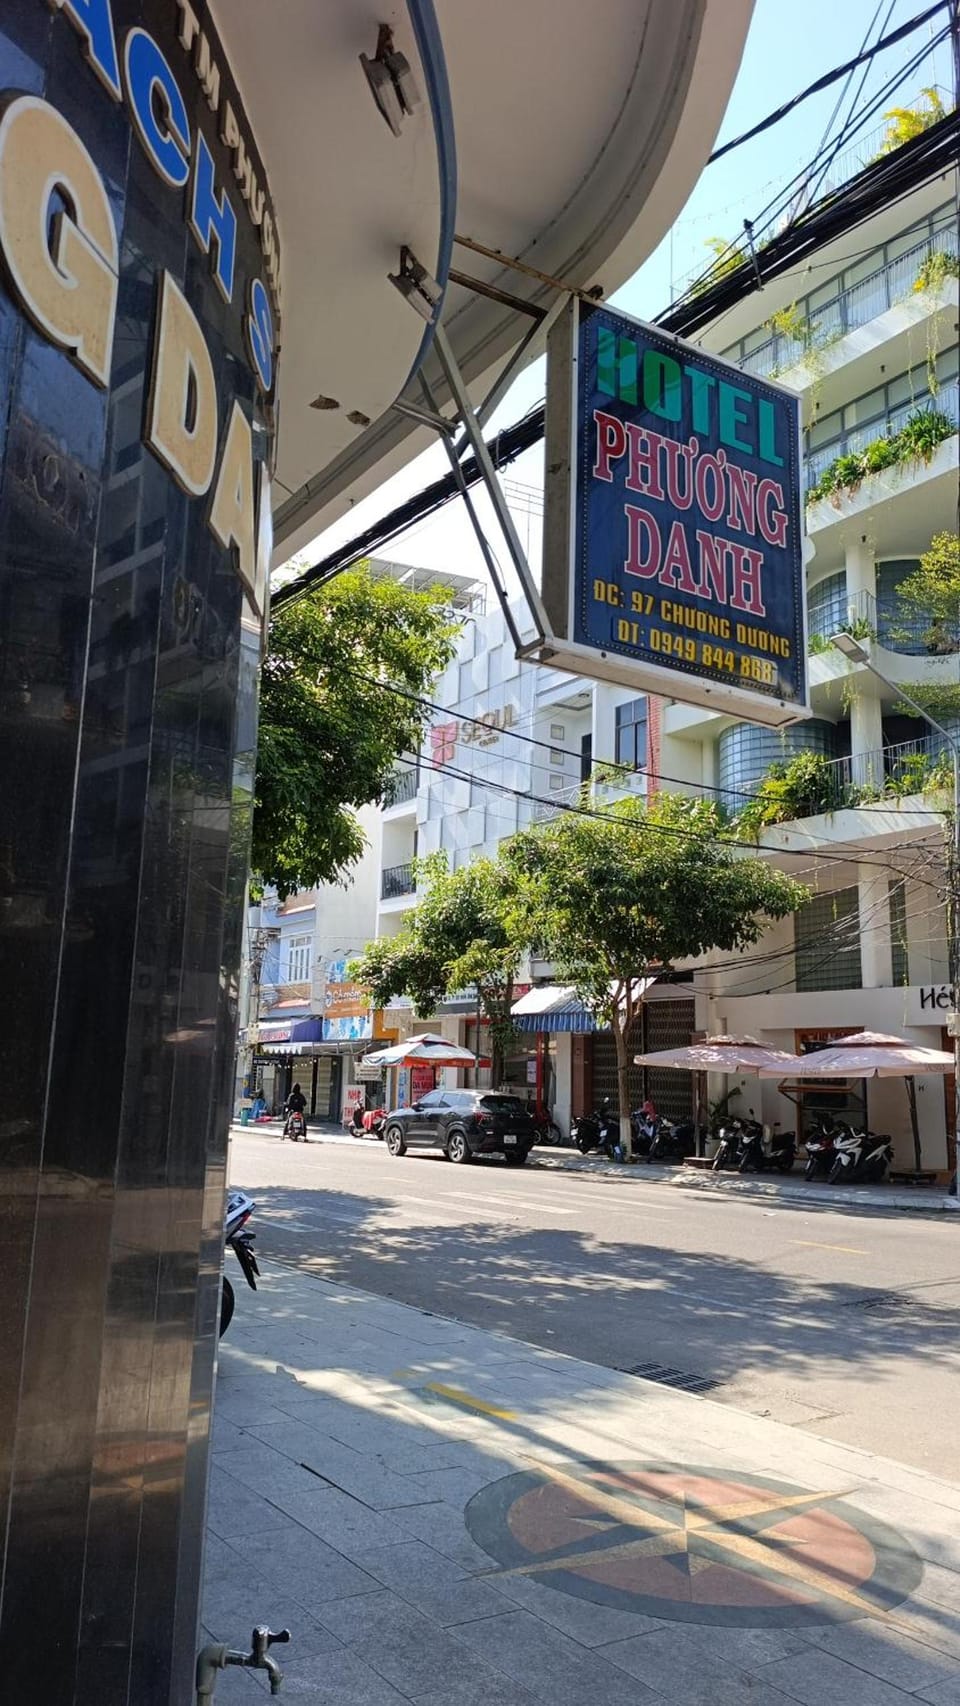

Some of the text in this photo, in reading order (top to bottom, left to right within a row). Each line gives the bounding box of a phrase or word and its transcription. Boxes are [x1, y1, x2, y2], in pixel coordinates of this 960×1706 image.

[596, 326, 785, 468] HOTEL
[592, 409, 789, 549] PHƯƠNG
[623, 503, 767, 618] DANH
[631, 590, 654, 616] 97
[660, 599, 731, 640] CHƯƠNG
[736, 623, 791, 659] DƯƠNG
[649, 628, 696, 664] 0949
[701, 644, 735, 673] 844
[739, 655, 773, 684] 868
